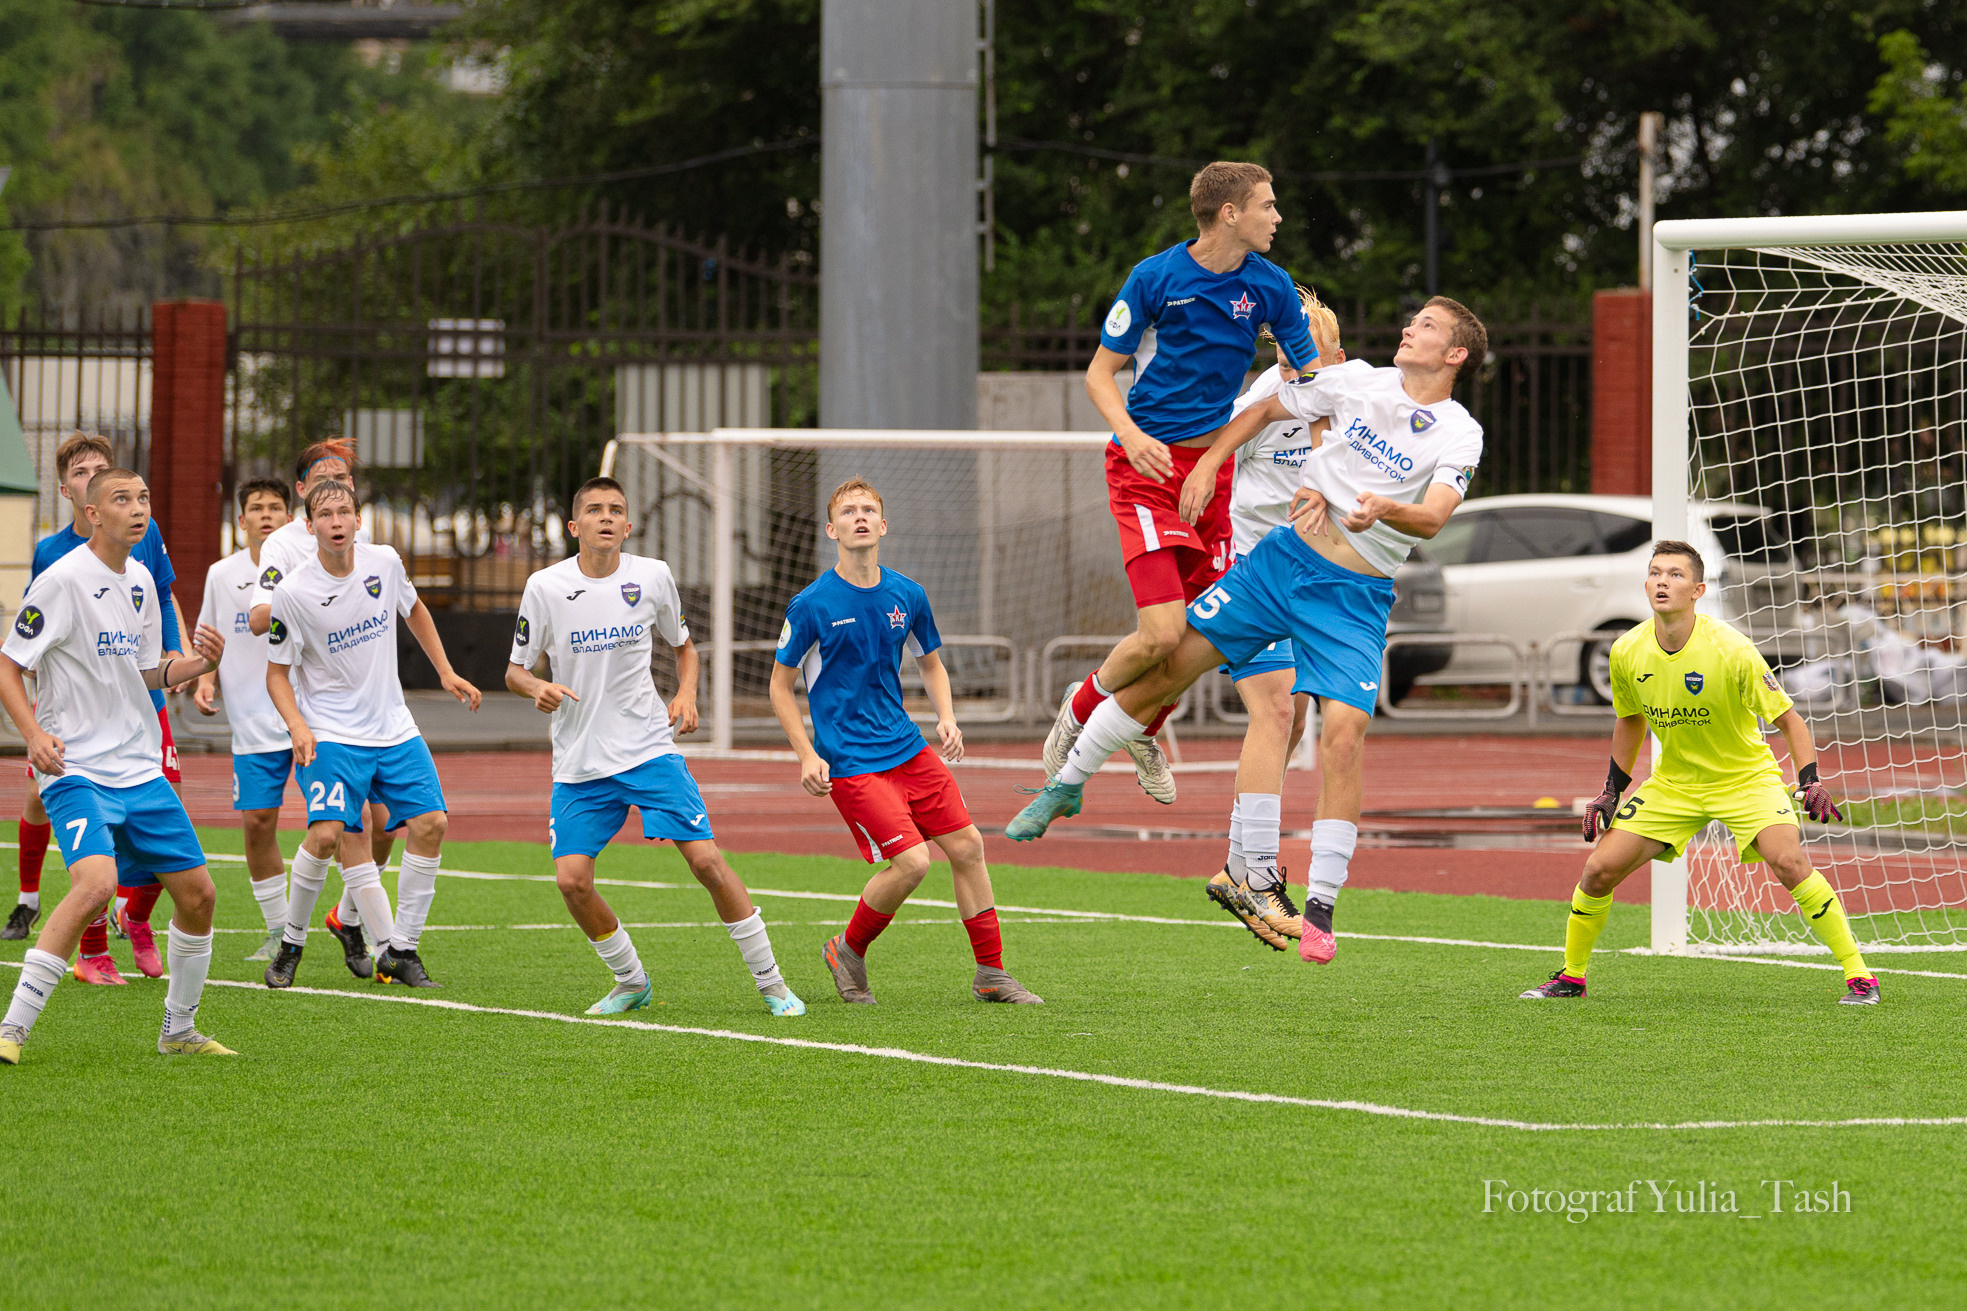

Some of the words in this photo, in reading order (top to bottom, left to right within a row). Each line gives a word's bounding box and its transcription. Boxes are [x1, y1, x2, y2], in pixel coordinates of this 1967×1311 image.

[328, 609, 389, 646] ДИНАМО
[570, 624, 644, 646] ДИНАМО
[309, 780, 346, 812] 24
[66, 817, 88, 852] 7
